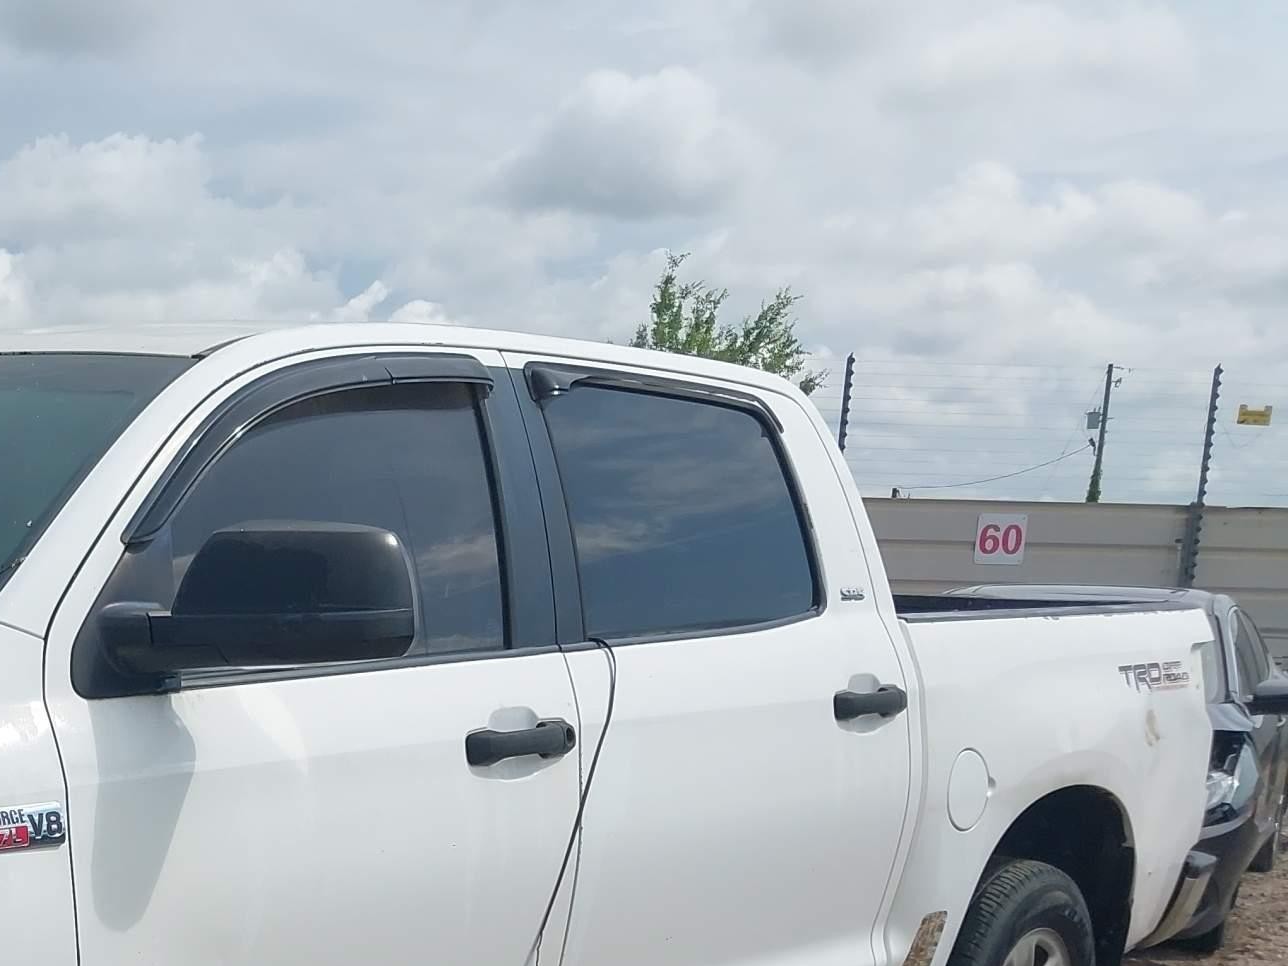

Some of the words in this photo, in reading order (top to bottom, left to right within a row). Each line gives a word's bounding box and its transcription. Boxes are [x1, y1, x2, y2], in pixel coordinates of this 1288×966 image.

[979, 523, 1022, 555] 60
[1118, 662, 1161, 693] TRD
[27, 811, 63, 840] V8
